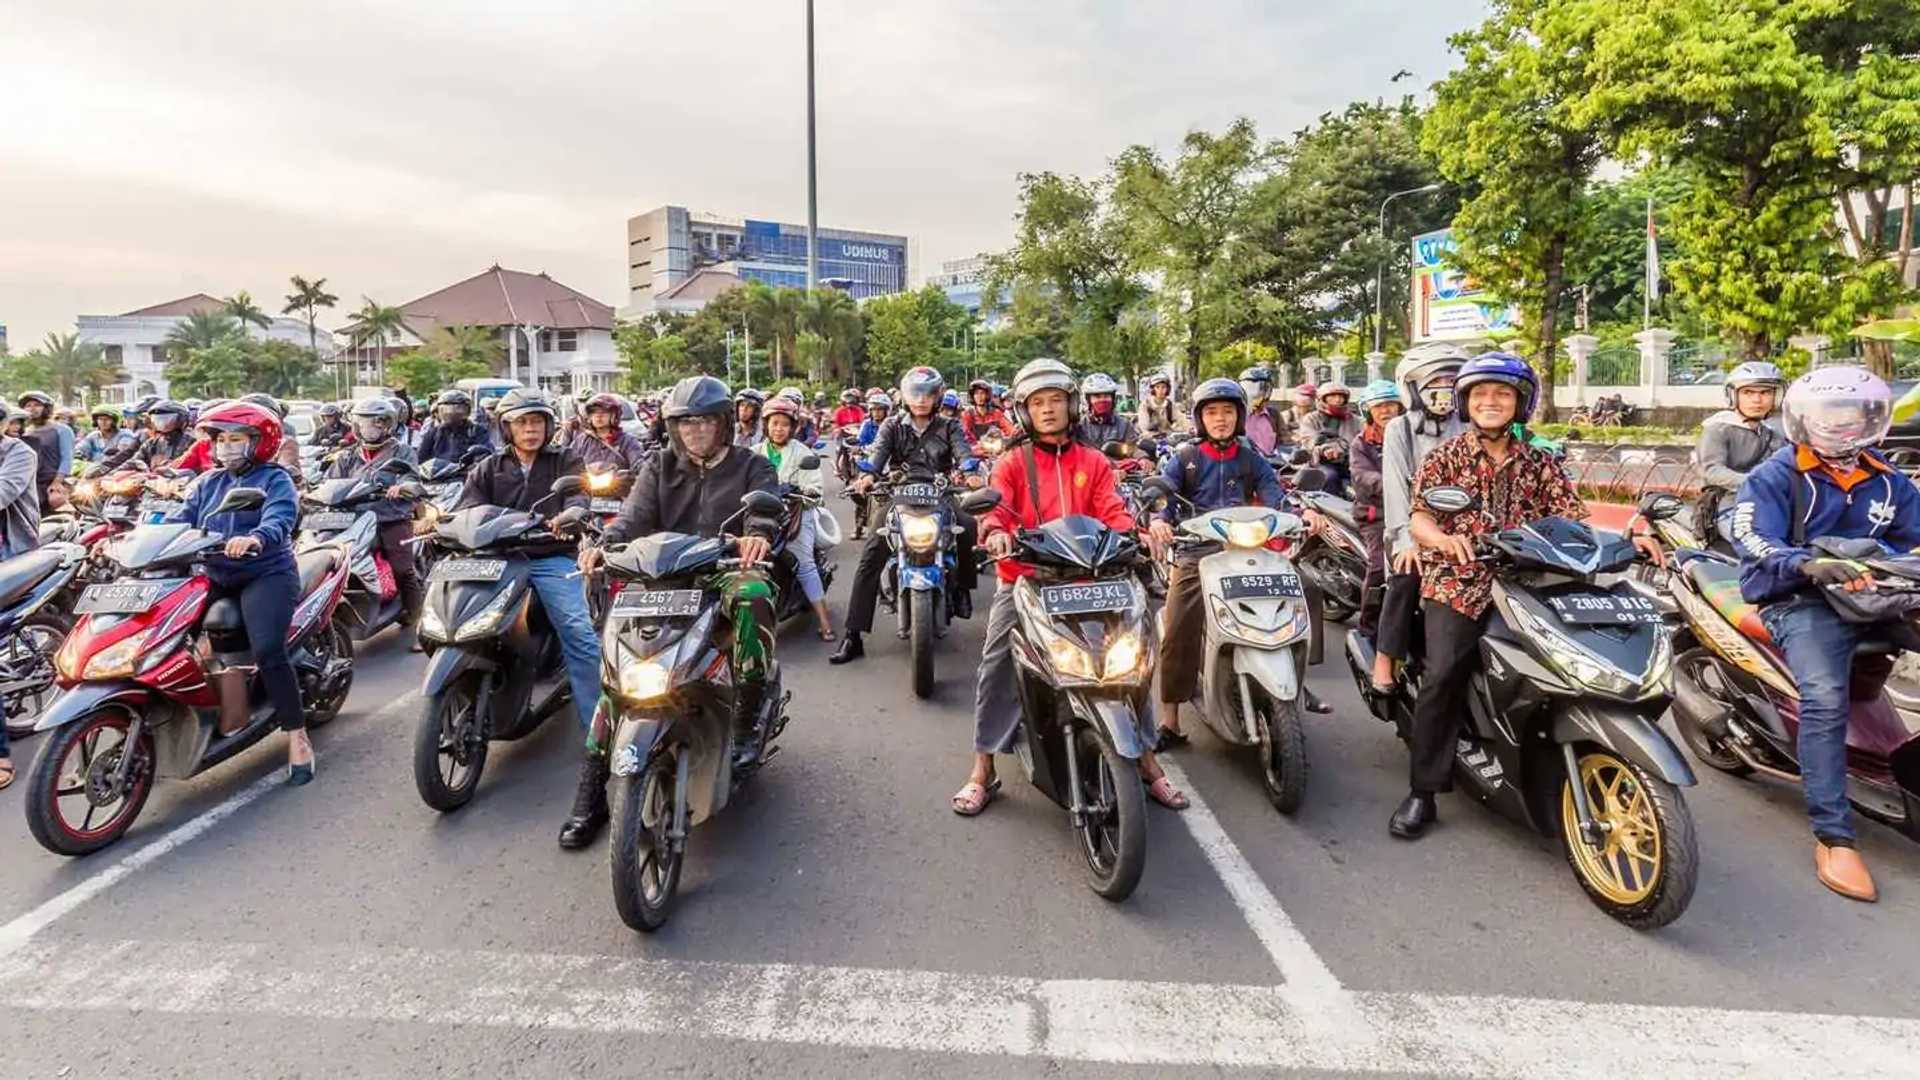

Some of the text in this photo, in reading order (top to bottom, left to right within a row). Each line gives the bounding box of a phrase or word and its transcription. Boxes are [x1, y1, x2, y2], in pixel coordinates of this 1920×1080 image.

[842, 244, 889, 260] UDINUS
[1223, 575, 1297, 589] H 6529 RF
[613, 591, 625, 607] H
[690, 590, 700, 602] E
[1047, 584, 1126, 603] G 6829 KL
[1550, 597, 1567, 610] H
[1618, 597, 1653, 610] BIG
[157, 659, 189, 681] HONDA
